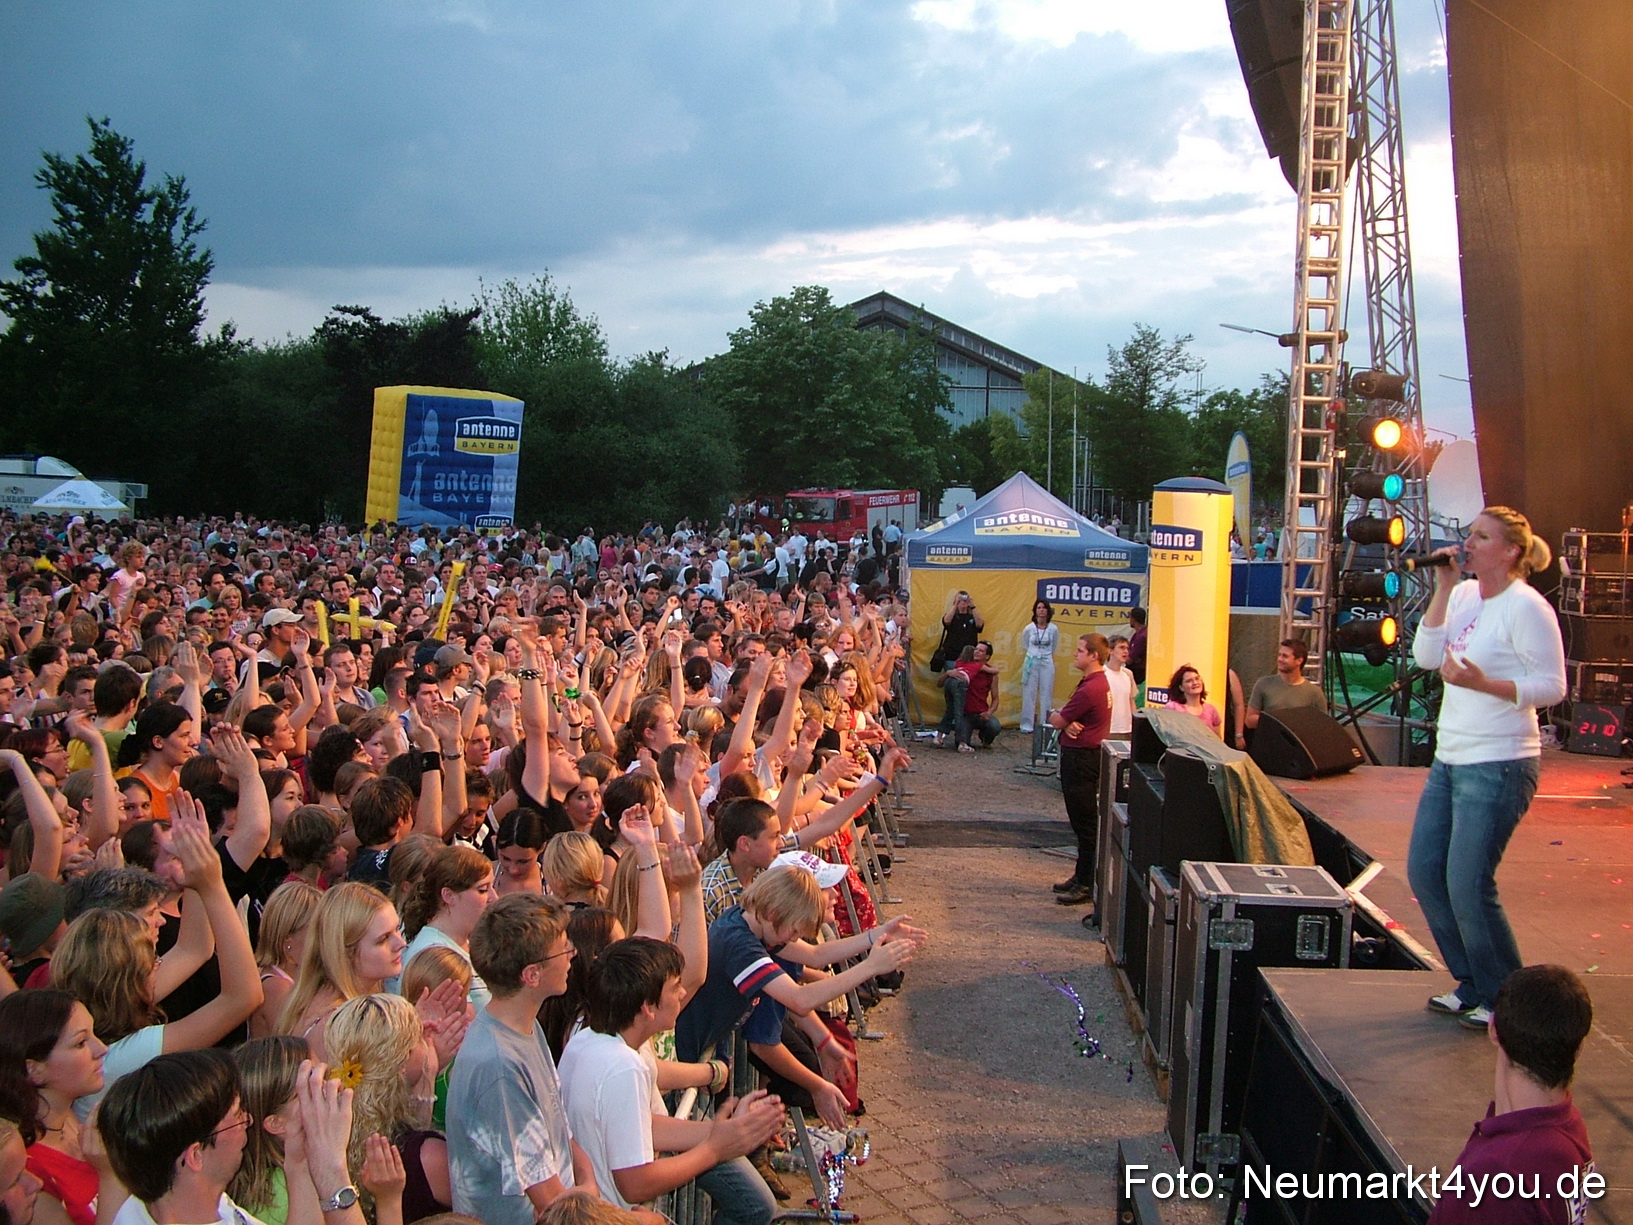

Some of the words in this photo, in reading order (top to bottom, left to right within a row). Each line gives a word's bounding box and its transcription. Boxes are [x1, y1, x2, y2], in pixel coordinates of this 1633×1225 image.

[462, 422, 515, 437] antenne
[462, 441, 514, 450] BAYERN
[434, 470, 516, 491] antenne
[433, 492, 515, 503] BAYERN
[869, 494, 900, 506] FEUERWEHR
[908, 492, 916, 502] 112
[983, 513, 1068, 528] antenne
[984, 525, 1070, 535] BAYERN
[1151, 530, 1195, 547] tenne
[930, 546, 968, 555] antenne
[1089, 550, 1127, 559] antenne
[1151, 552, 1194, 561] YERN
[1045, 582, 1132, 603] antenne
[1052, 608, 1131, 619] AYERN
[1148, 690, 1168, 703] ante
